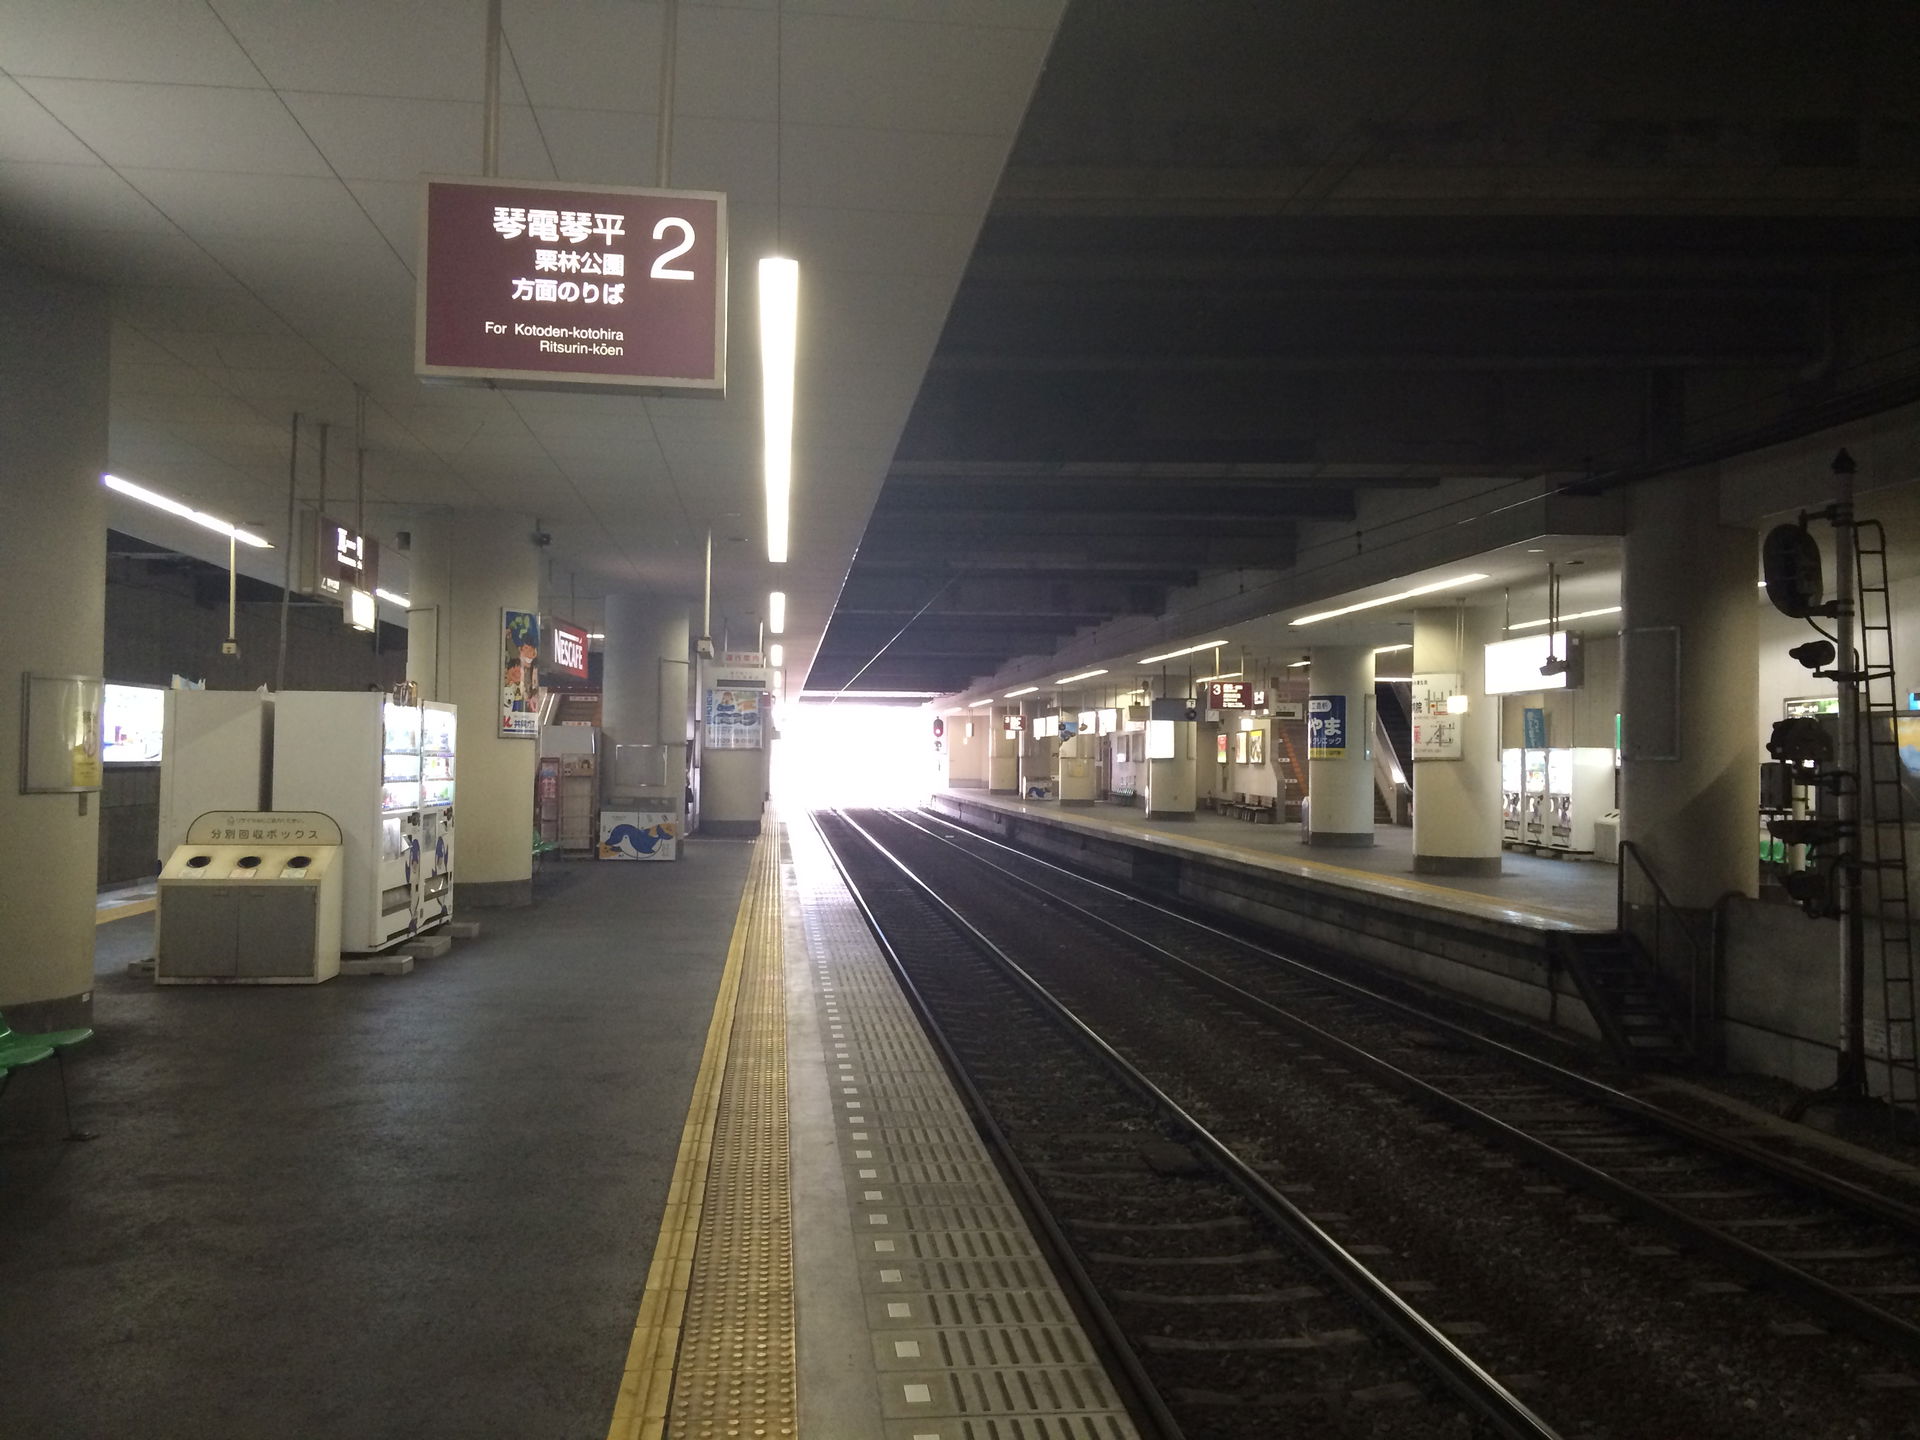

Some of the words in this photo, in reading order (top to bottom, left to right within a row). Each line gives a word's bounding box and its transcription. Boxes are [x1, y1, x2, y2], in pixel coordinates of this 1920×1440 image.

[492, 206, 626, 246] 琴電琴平
[650, 216, 696, 281] 2
[535, 249, 625, 277] 栗林公園
[511, 277, 625, 306] 方面のりば
[485, 321, 508, 335] For
[514, 322, 624, 342] Kotoden-kotohira
[539, 340, 624, 357] Ritsurin-kōen
[1212, 684, 1221, 695] 3
[211, 829, 318, 840] 分別回収ボックス
